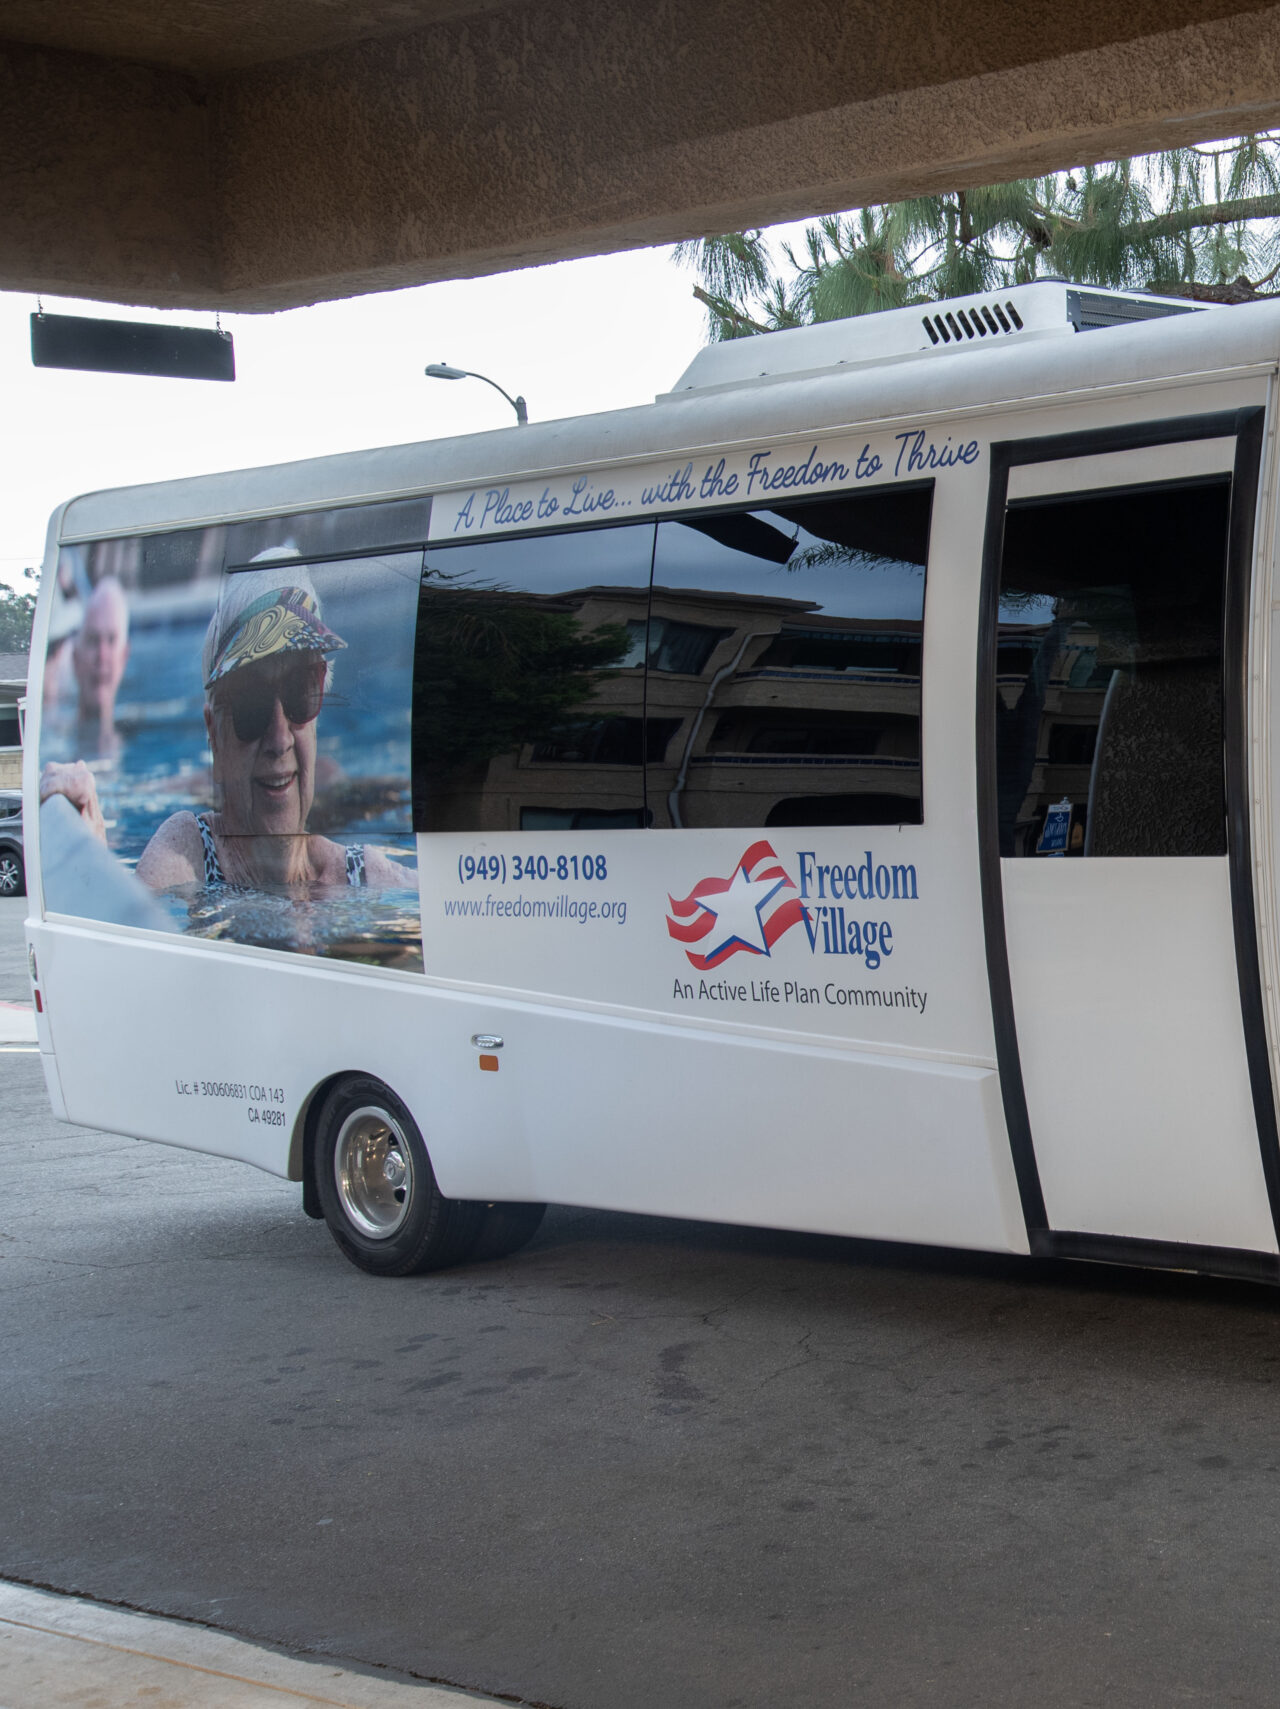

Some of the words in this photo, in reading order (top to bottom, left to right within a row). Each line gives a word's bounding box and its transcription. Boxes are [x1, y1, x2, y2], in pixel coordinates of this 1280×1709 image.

[454, 491, 477, 533] A
[479, 487, 535, 529] Place
[537, 487, 560, 520] to
[641, 462, 696, 505] with
[699, 458, 740, 499] the
[747, 444, 850, 496] Freedom
[855, 443, 883, 480] to
[894, 430, 980, 477] Thrive
[458, 854, 506, 884] (949)
[512, 854, 607, 883] 340-8108
[796, 851, 919, 900] Freedom
[444, 893, 628, 925] www.freedomvillage.org
[800, 906, 893, 970] Village
[673, 978, 695, 1000] An
[699, 979, 748, 1001] Active
[751, 981, 781, 1003] Life
[784, 982, 821, 1005] Plan
[824, 983, 928, 1014] Community
[176, 1080, 192, 1095] Lic.
[194, 1081, 200, 1095] #
[249, 1085, 268, 1102] COA
[269, 1087, 285, 1104] 143
[248, 1107, 260, 1124] CA
[262, 1110, 286, 1127] 49281
